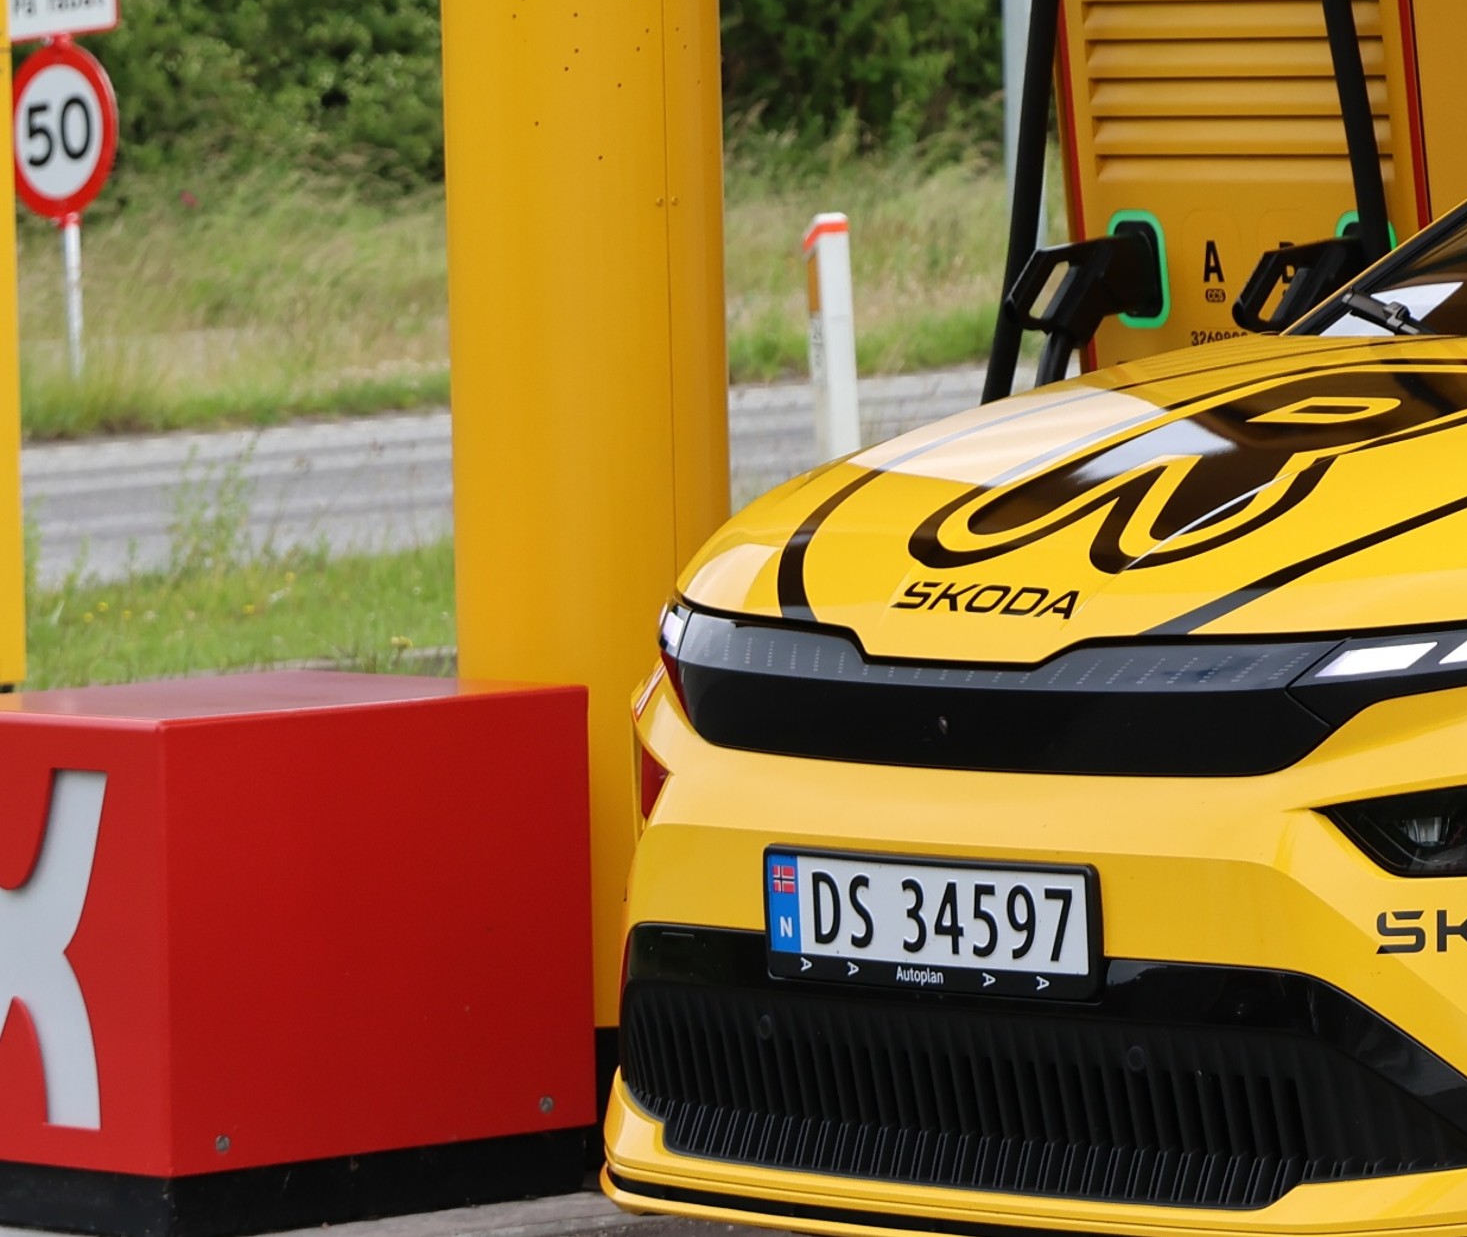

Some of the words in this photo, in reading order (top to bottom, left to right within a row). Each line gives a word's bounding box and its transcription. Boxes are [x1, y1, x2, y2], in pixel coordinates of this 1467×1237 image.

[28, 95, 92, 168] 50
[1203, 240, 1225, 283] A
[1207, 289, 1225, 301] CCS
[778, 915, 794, 939] N
[811, 869, 876, 950] DS
[900, 876, 1074, 963] 34597
[895, 964, 945, 988] Autoplan
